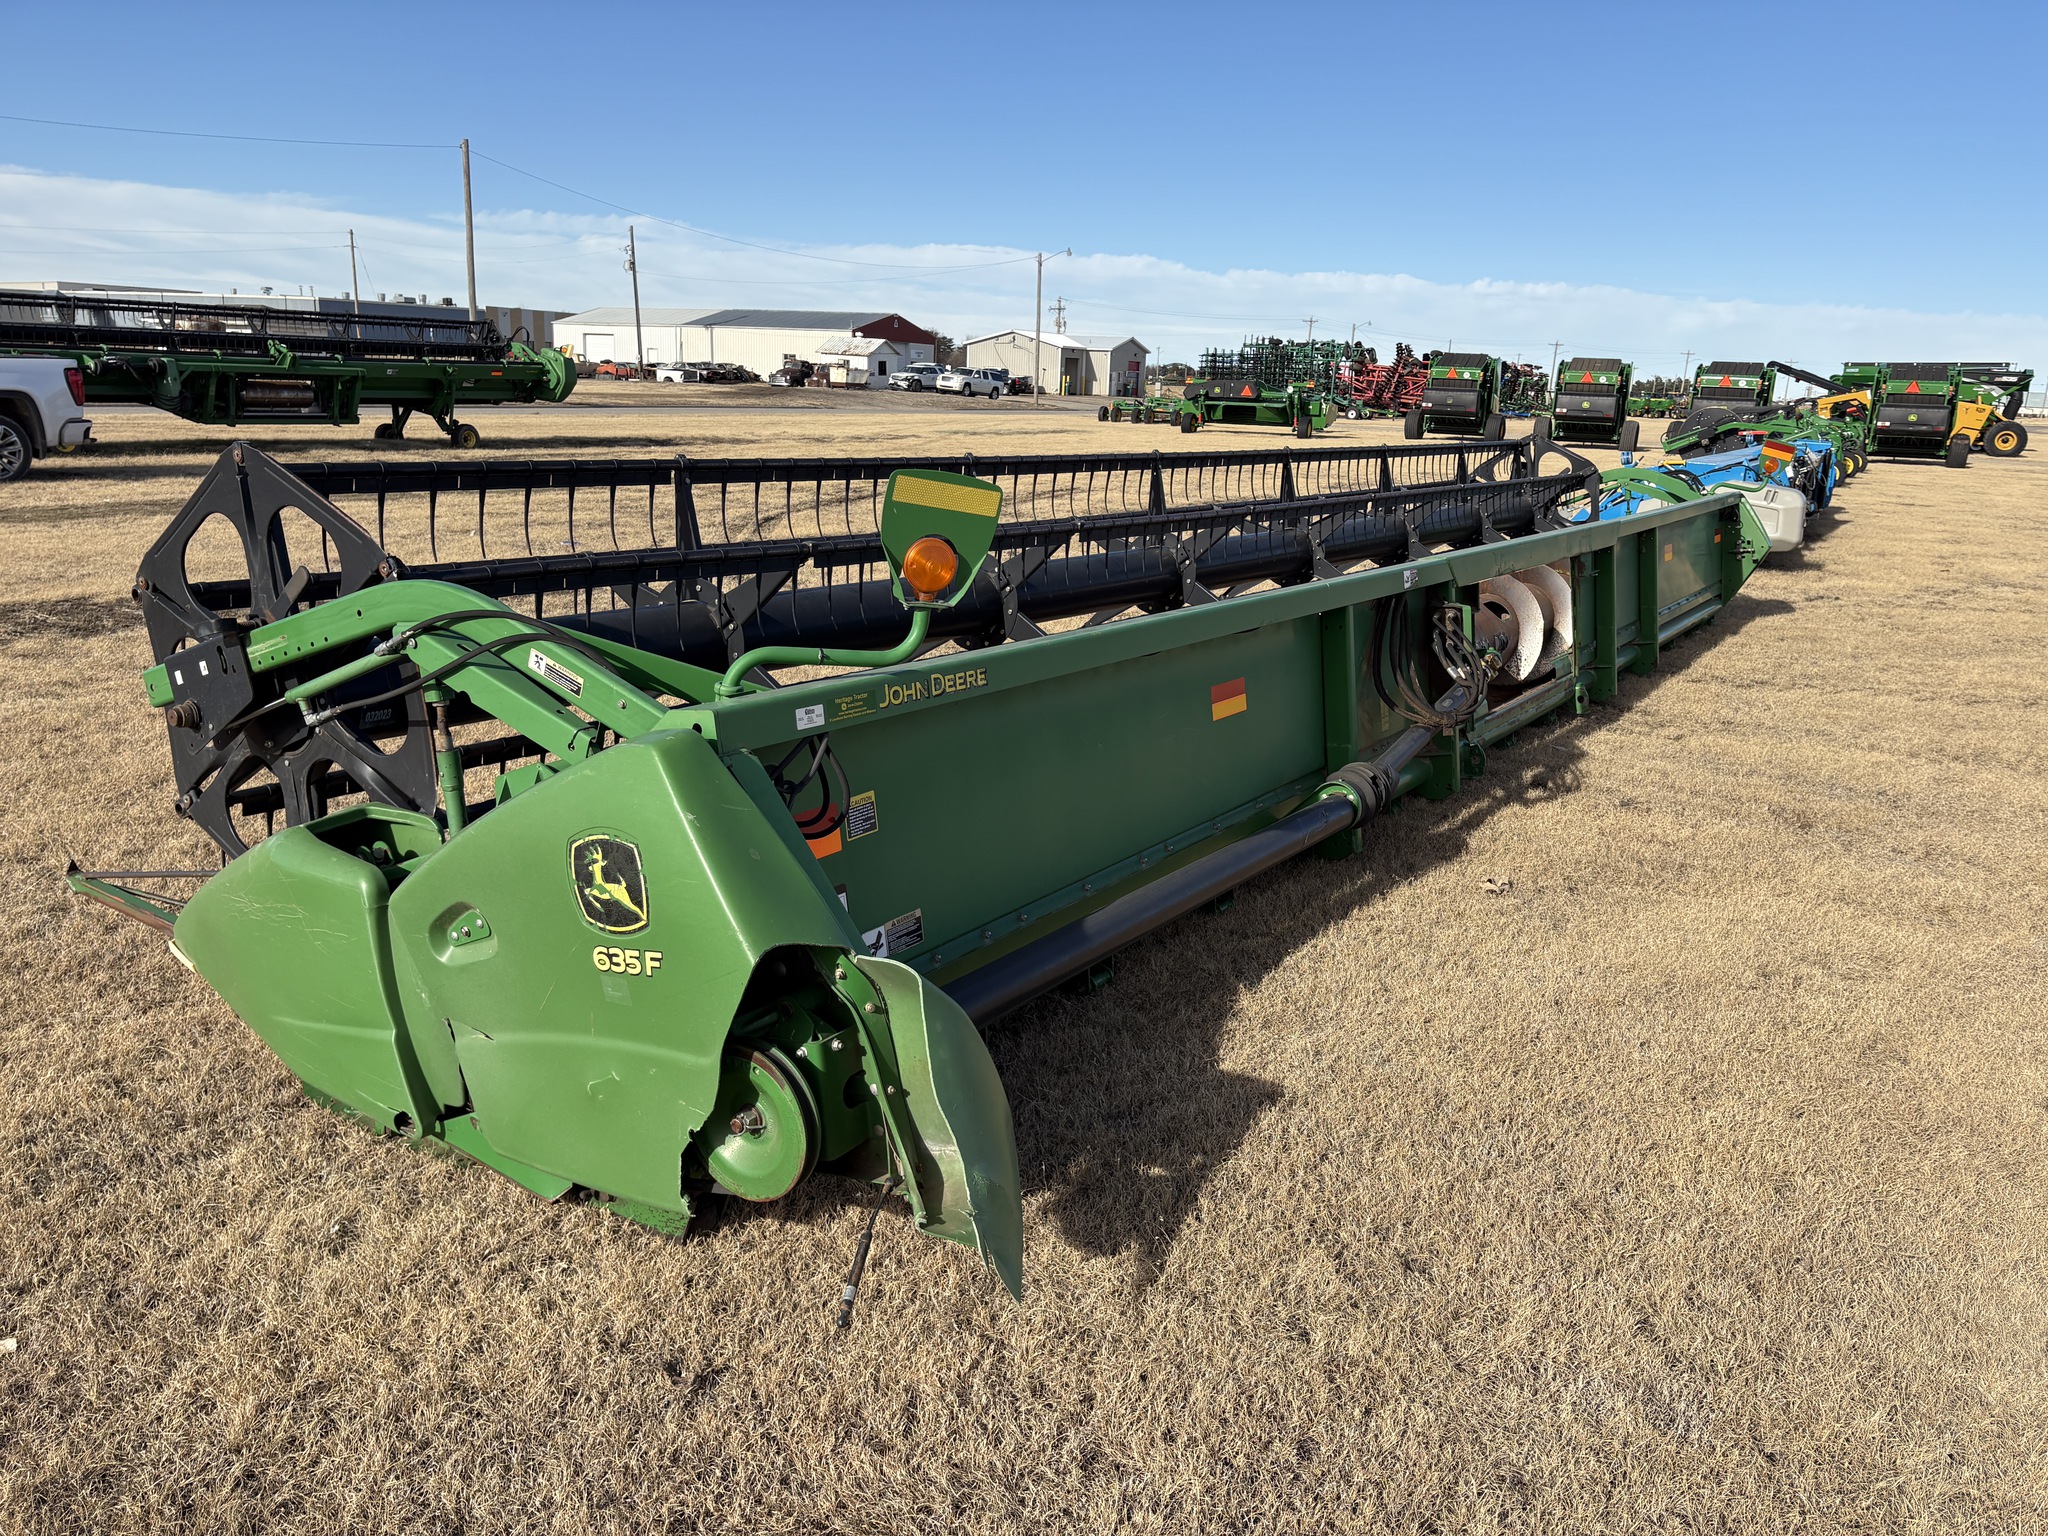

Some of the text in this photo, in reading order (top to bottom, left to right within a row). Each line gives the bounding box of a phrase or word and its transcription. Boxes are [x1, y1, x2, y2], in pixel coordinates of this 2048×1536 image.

[879, 667, 988, 708] JOHN DEERE
[834, 692, 868, 704] Heritage Tractor
[850, 795, 873, 807] CAUTION
[896, 911, 917, 925] WARNING
